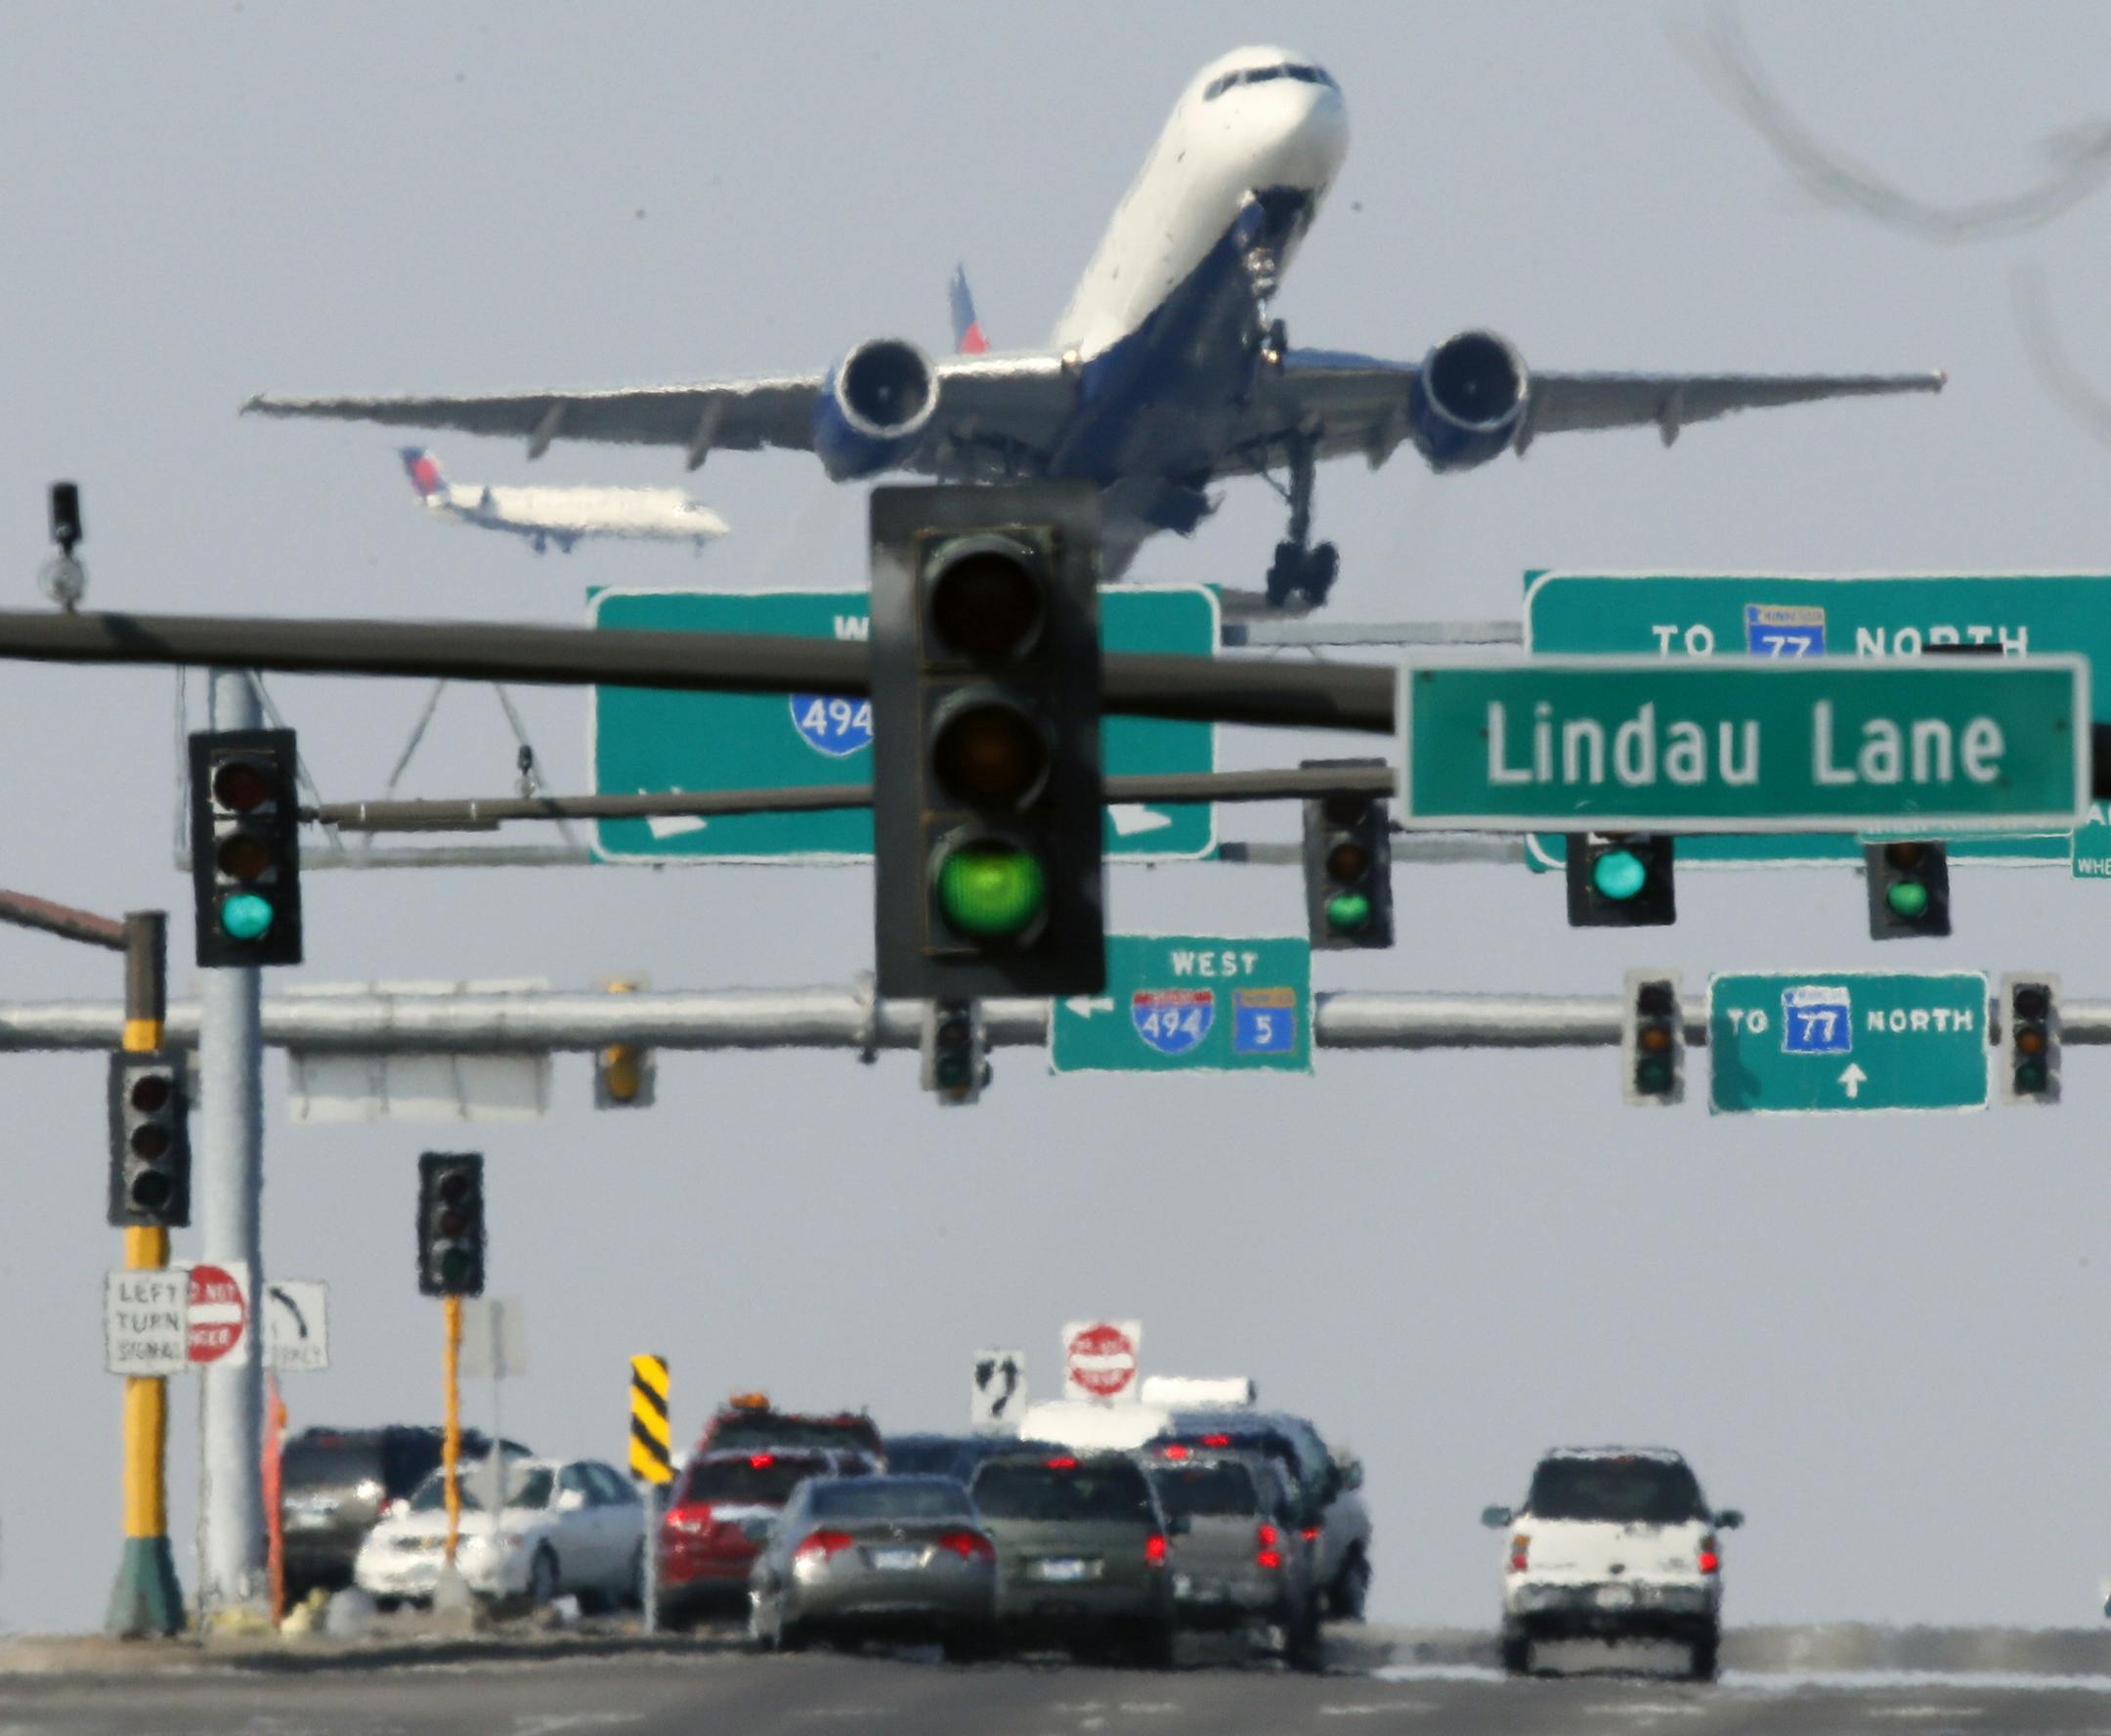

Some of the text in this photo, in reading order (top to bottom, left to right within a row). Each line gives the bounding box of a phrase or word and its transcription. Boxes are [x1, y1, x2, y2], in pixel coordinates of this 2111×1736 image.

[1652, 624, 1714, 658] TO
[1762, 636, 1811, 658] 77
[801, 698, 874, 736] 494
[1486, 699, 2005, 785] Lindau Lane
[1171, 951, 1258, 976] WEST
[1142, 1009, 1273, 1045] 494 5
[1726, 1009, 1973, 1042] TO 77 NORTH
[119, 1282, 177, 1303] LEFT
[116, 1312, 179, 1334] TURN
